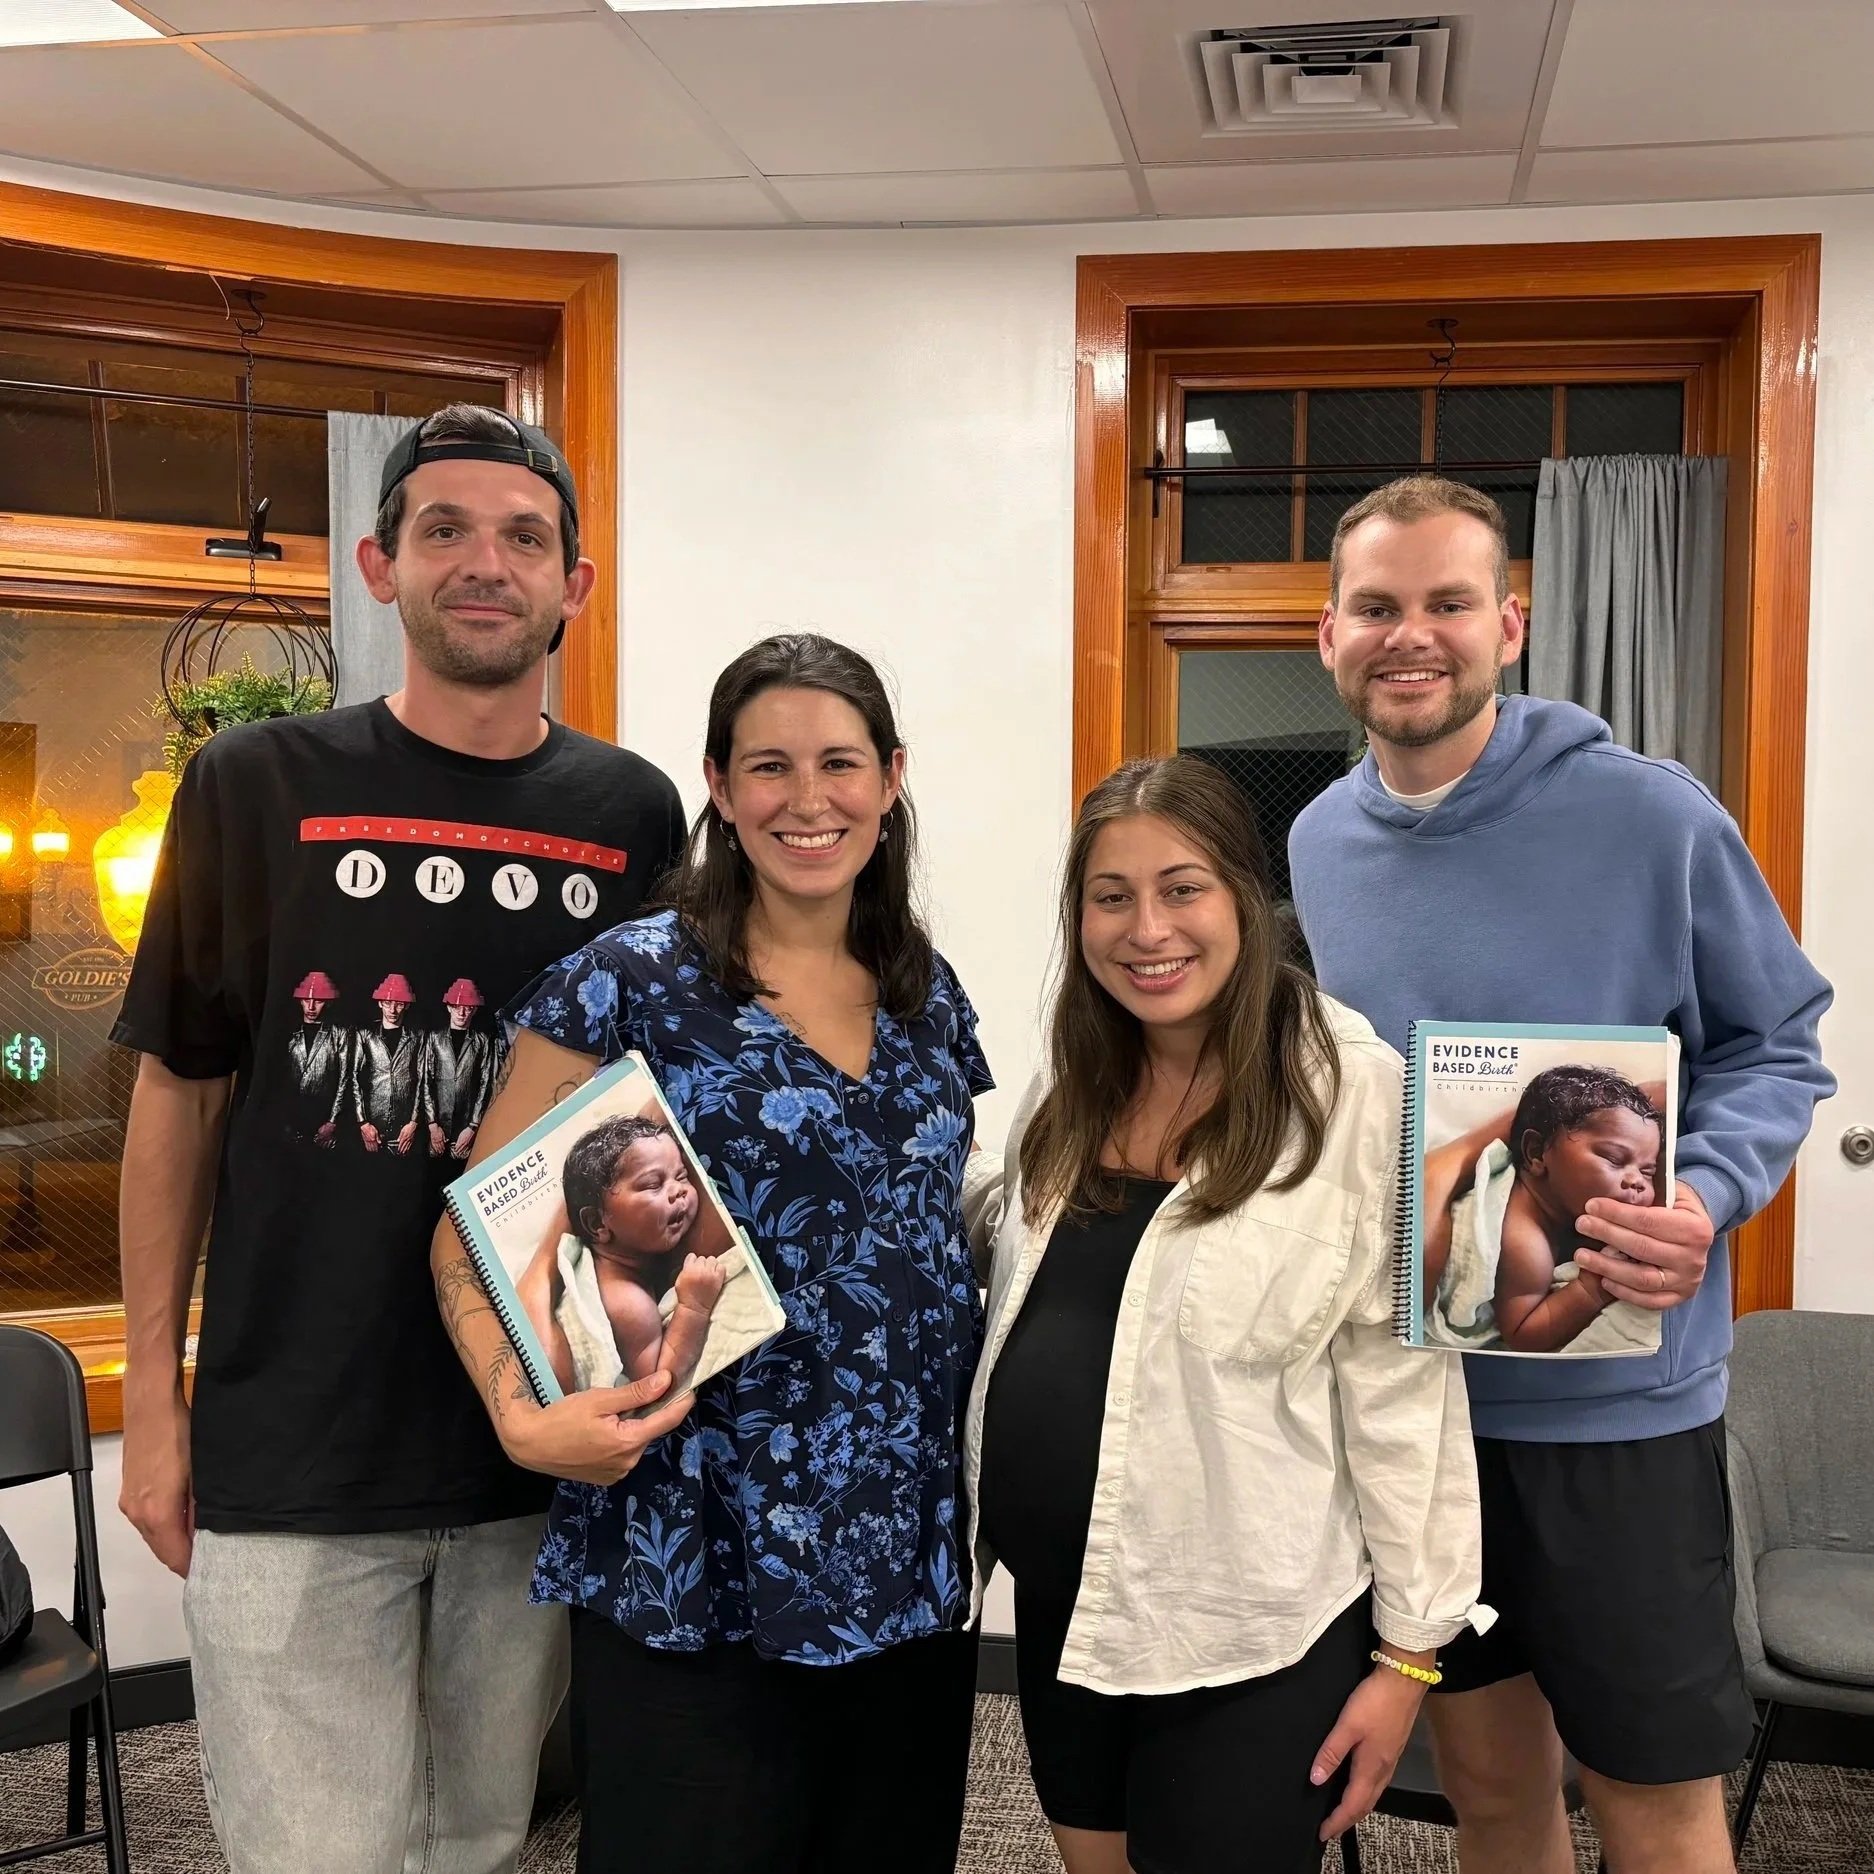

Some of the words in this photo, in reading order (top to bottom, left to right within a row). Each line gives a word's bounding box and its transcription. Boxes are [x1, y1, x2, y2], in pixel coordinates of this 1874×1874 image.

[345, 859, 590, 910] DEVO
[44, 970, 130, 986] GOLDIE'S
[1433, 1044, 1519, 1059] EVIDENCE
[1433, 1062, 1475, 1074] BASED
[477, 1150, 545, 1204] EVIDENCE
[484, 1188, 518, 1217] BASED
